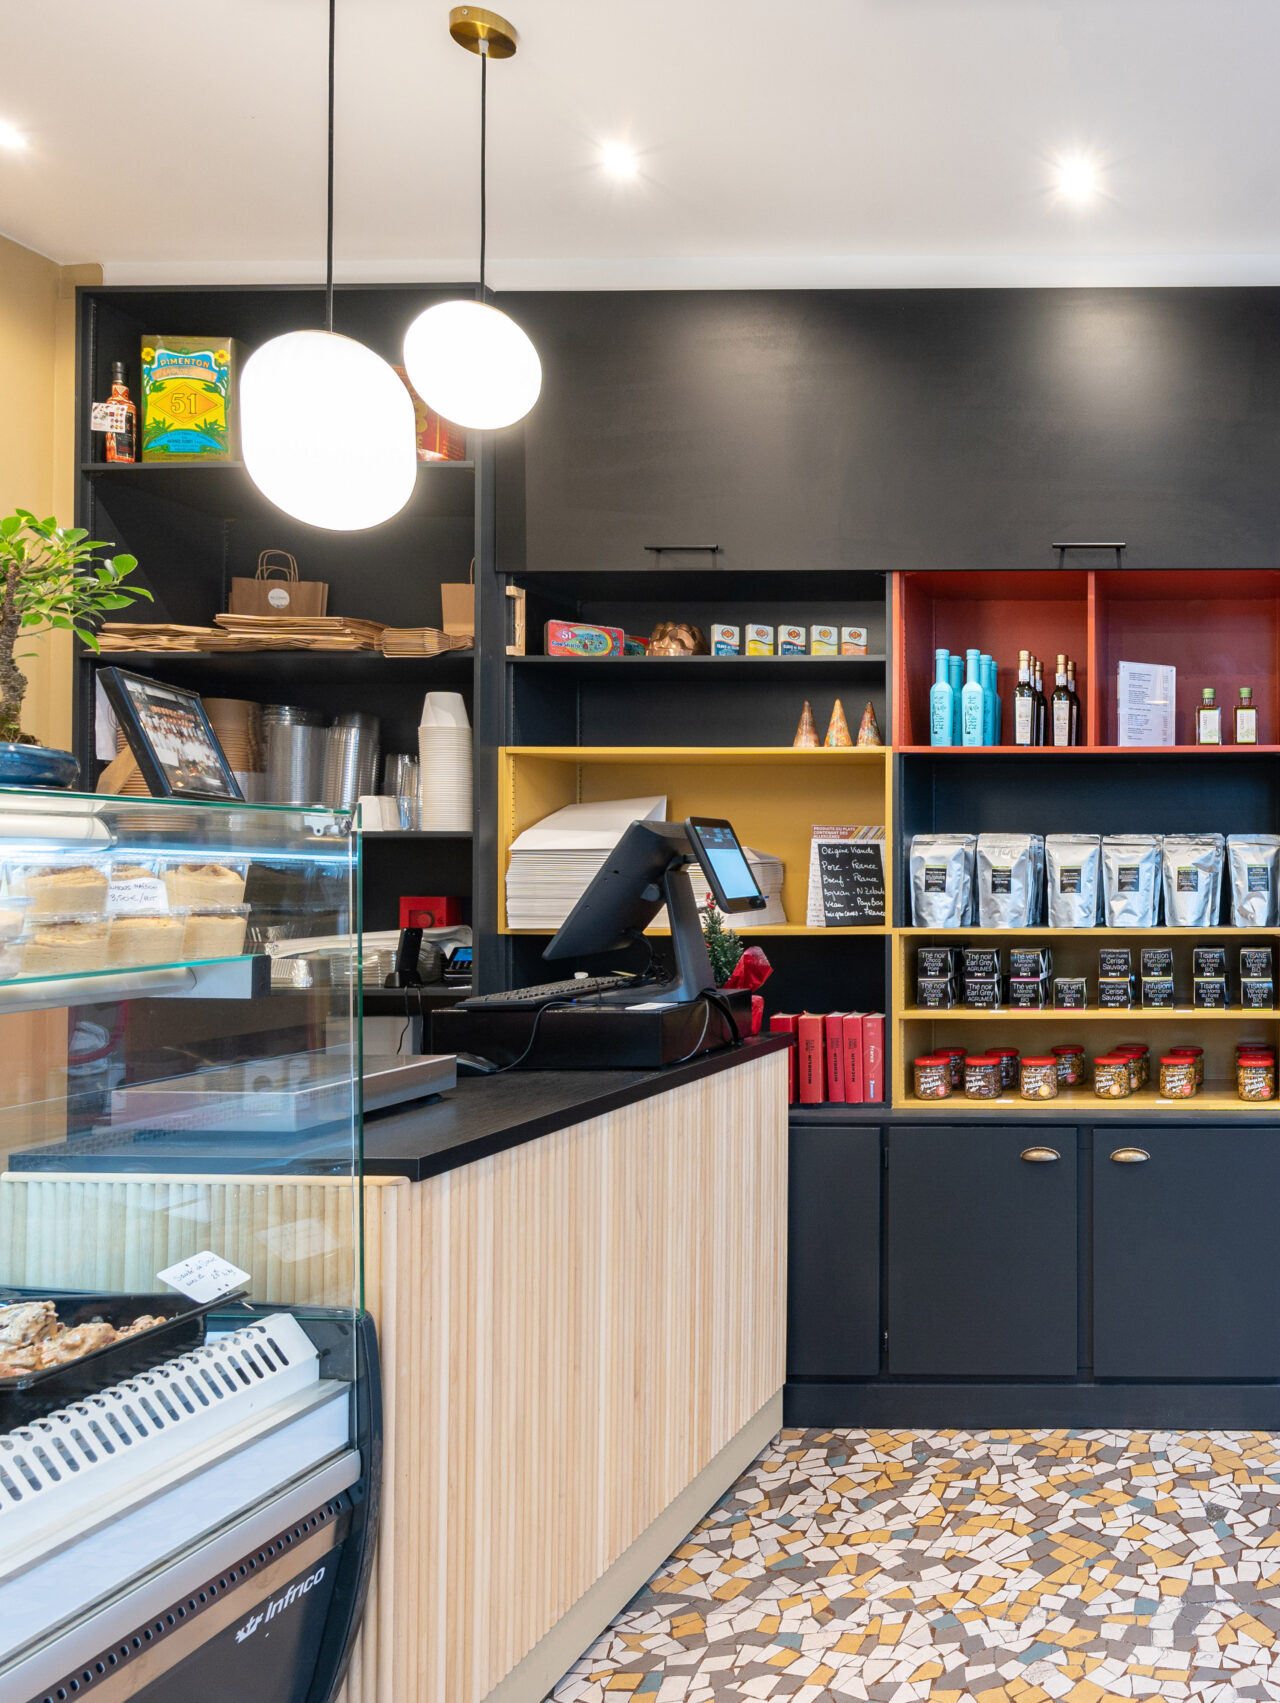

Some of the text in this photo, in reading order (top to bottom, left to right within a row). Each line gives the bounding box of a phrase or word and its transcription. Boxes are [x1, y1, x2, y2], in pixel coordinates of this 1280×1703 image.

[160, 358, 209, 368] PIMENTON
[171, 393, 197, 414] 51
[822, 846, 849, 858] Origine
[821, 859, 878, 870] Porc France
[853, 873, 878, 882] France
[1102, 994, 1127, 1002] Sauvage
[265, 1567, 325, 1623] Infrico
